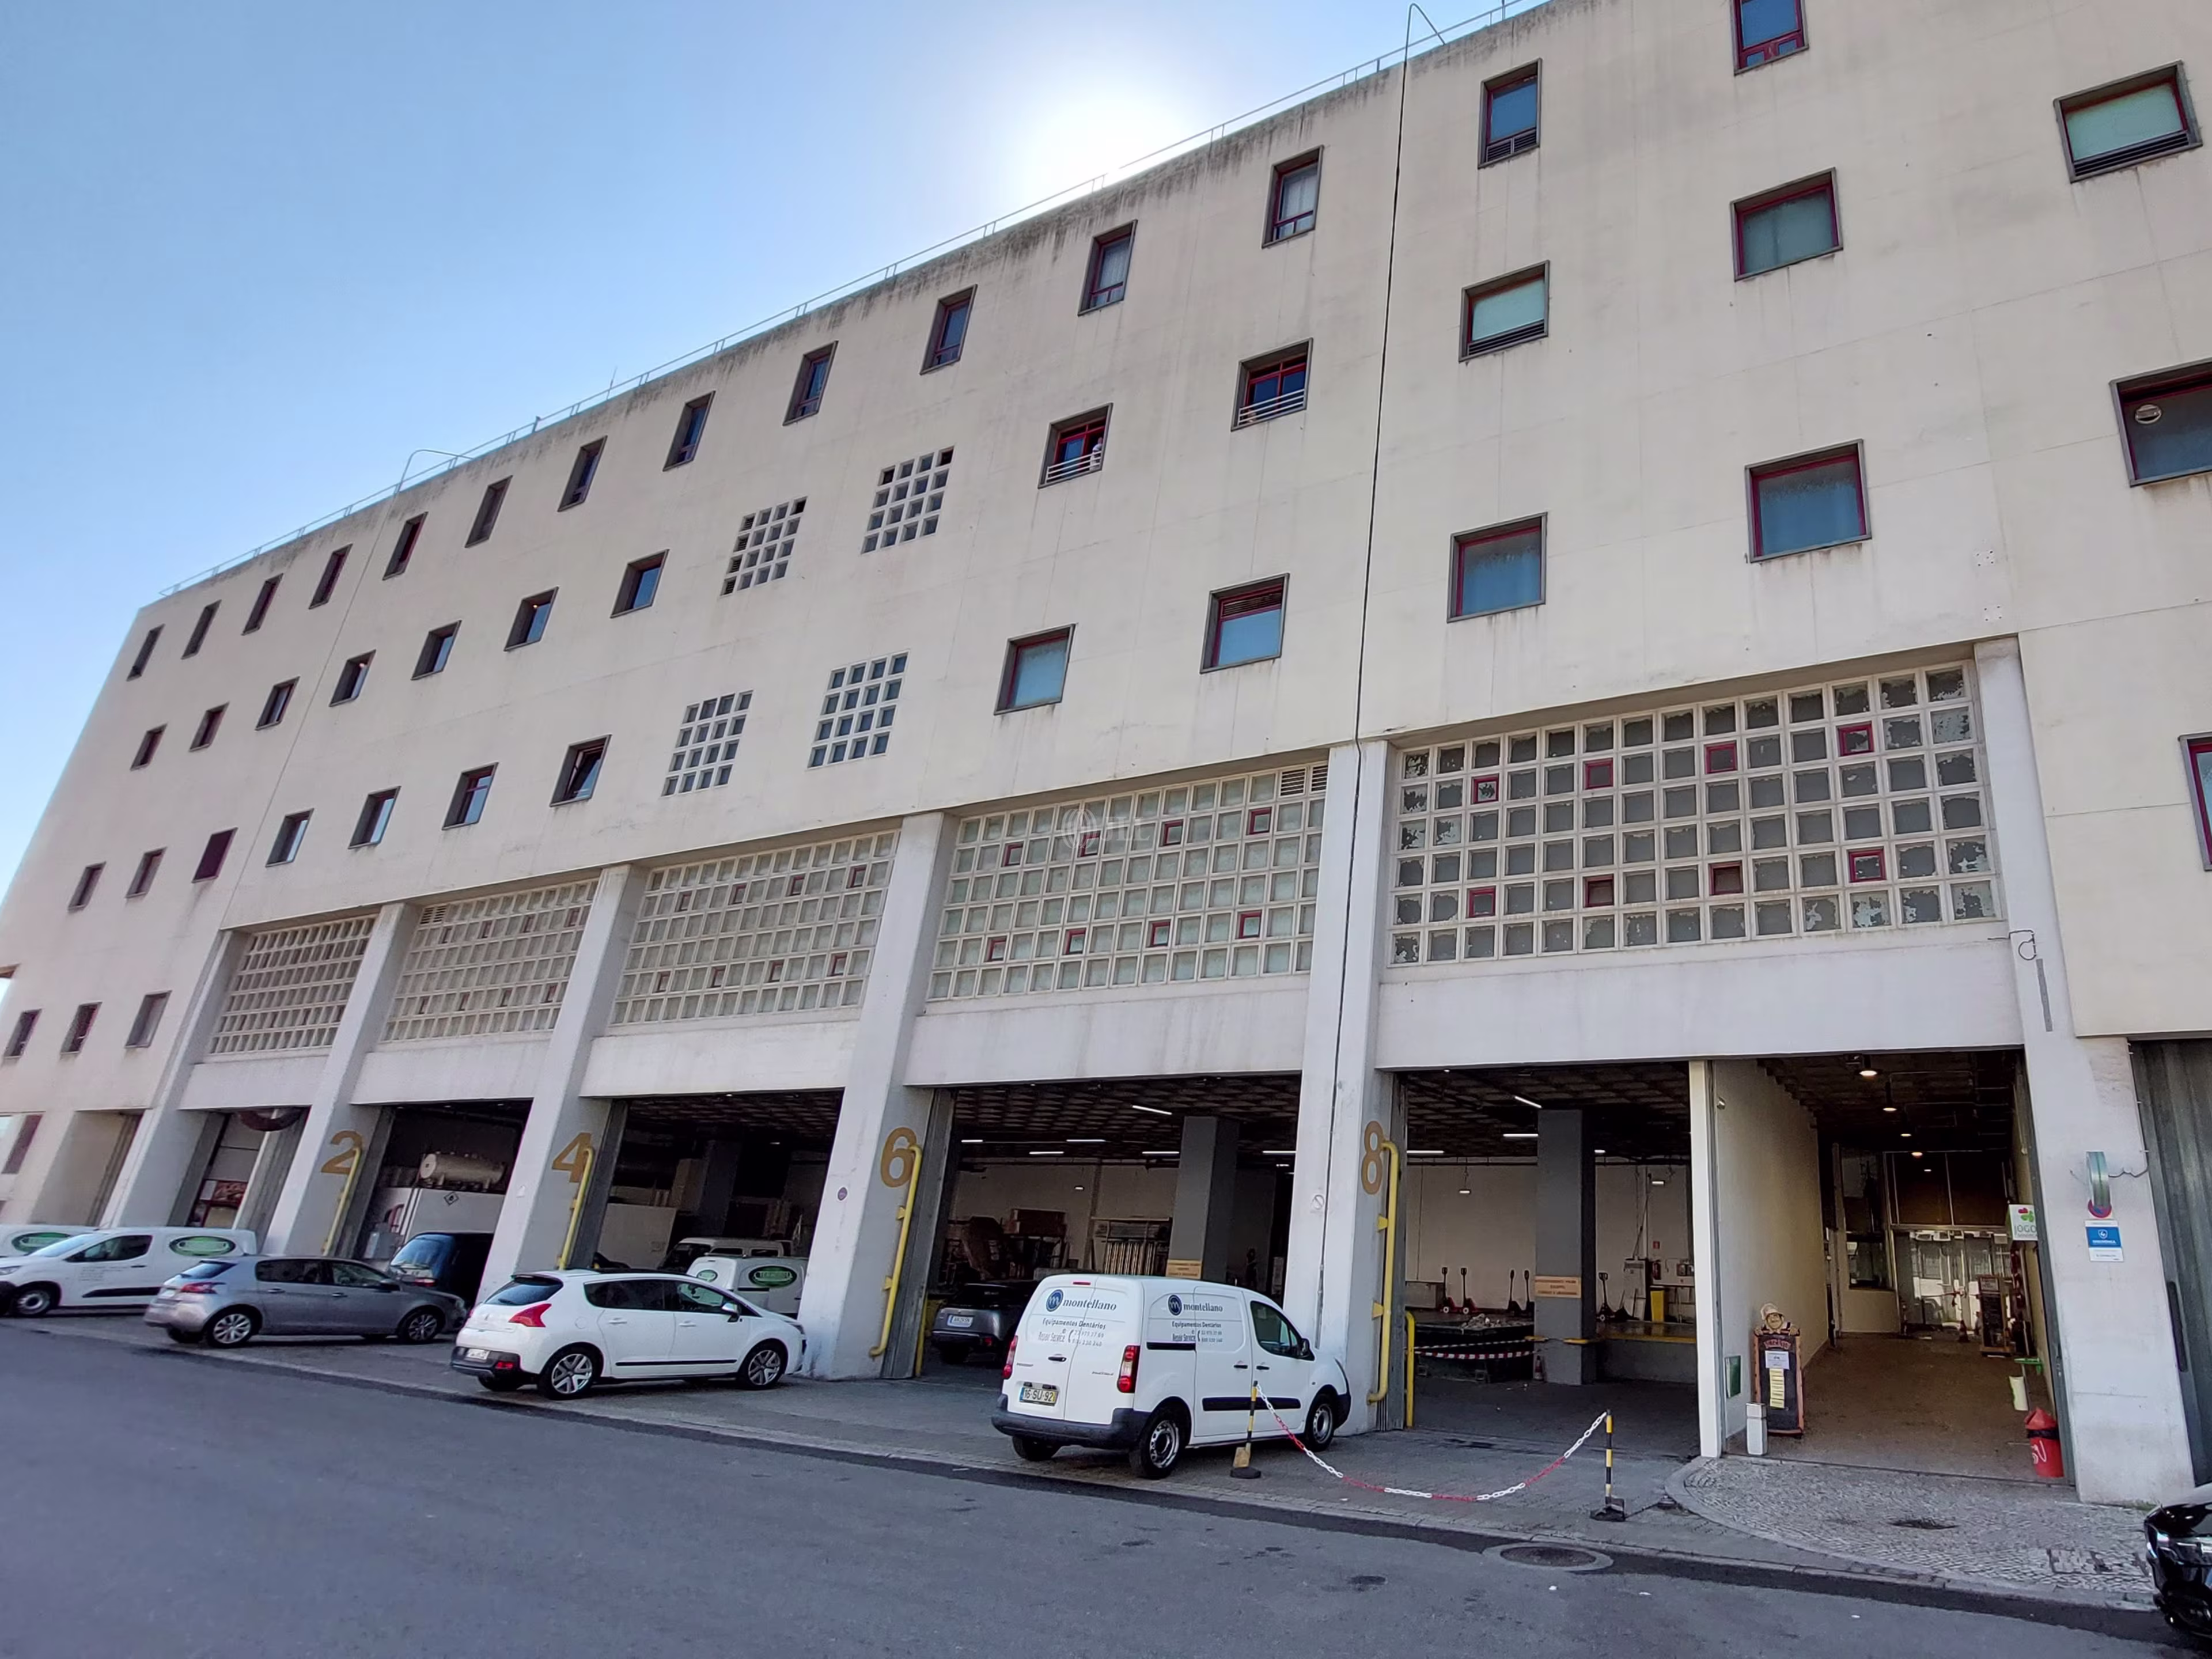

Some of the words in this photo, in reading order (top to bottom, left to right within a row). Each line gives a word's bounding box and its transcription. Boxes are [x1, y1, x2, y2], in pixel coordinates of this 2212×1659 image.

[320, 1130, 362, 1175] 2
[551, 1132, 592, 1183] 4
[880, 1127, 917, 1188] 6
[1361, 1120, 1383, 1195] 8
[1062, 1299, 1117, 1310] montellano
[1183, 1302, 1223, 1312] montellano
